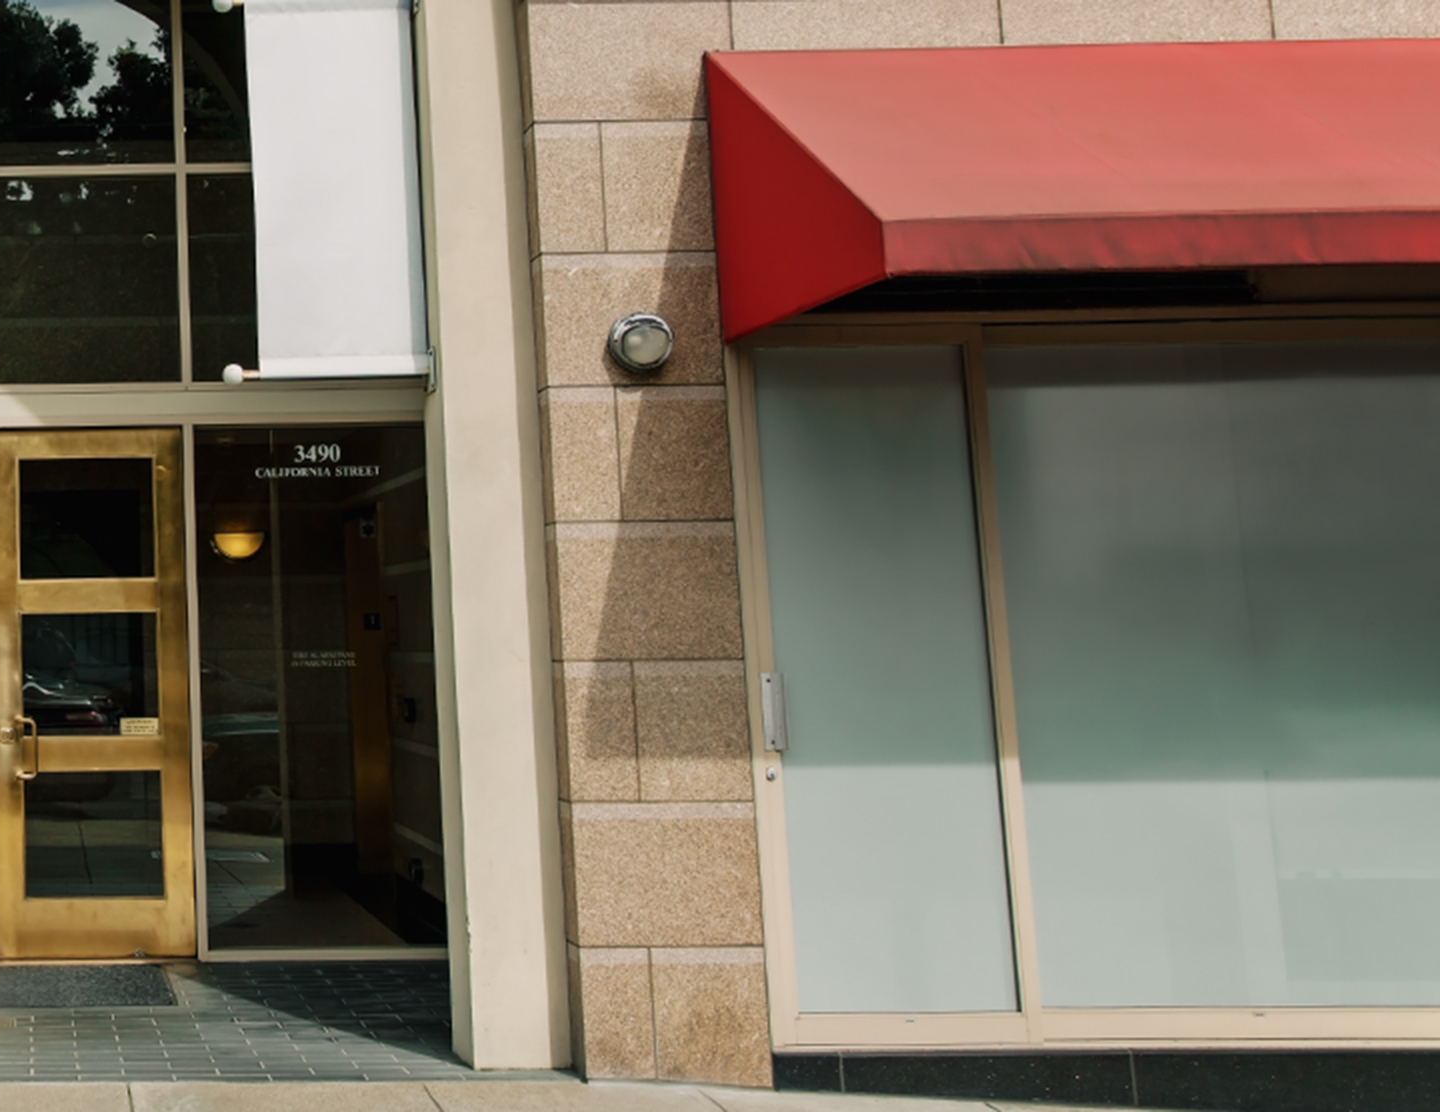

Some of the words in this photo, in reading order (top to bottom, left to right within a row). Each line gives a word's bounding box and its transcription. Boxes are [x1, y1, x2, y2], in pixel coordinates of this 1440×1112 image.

[293, 443, 341, 463] 3490
[255, 467, 331, 478] CALIFORNIA
[335, 465, 381, 477] STREET
